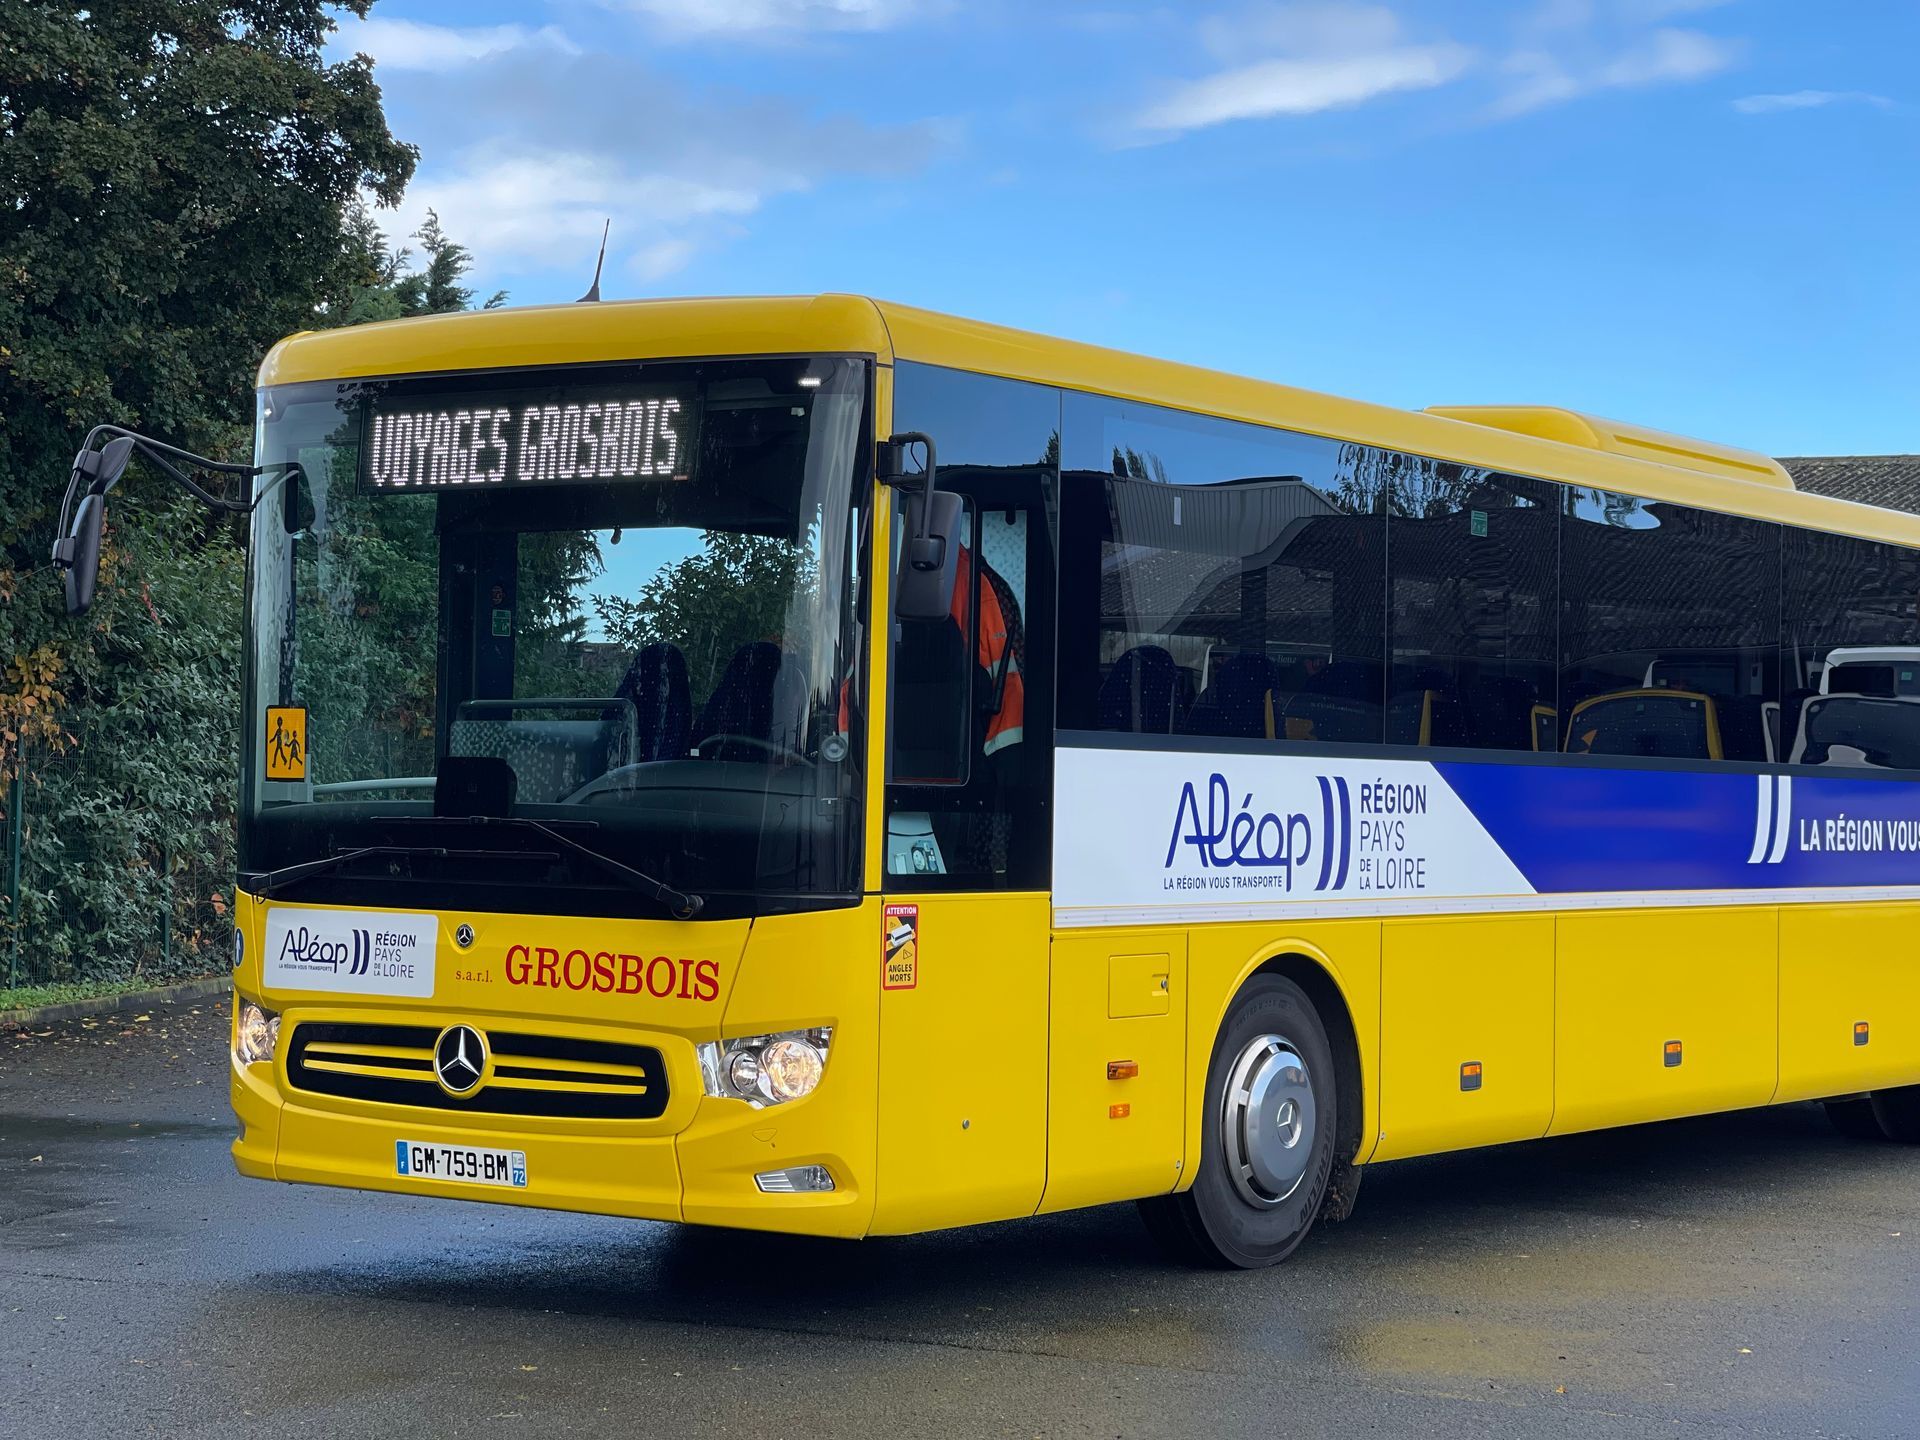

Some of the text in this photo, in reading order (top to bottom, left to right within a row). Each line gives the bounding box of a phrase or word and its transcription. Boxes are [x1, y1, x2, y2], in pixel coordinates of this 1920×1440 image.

[371, 398, 681, 486] VOYAGES GROSBOIS
[1360, 777, 1427, 815] RÉGION
[1360, 820, 1405, 851] PAYS
[1800, 819, 1821, 851] LA
[1825, 813, 1883, 851] RÉGION
[1359, 857, 1426, 889] DE LOIRE
[1163, 874, 1283, 890] LA RÉGION VOUS TRANSPORTE
[1359, 876, 1371, 890] LA
[886, 907, 917, 915] ATTENTION
[375, 930, 417, 948] RÉGION
[374, 947, 402, 963] PAYS
[373, 962, 415, 979] DE LOIRE
[455, 969, 493, 983] s.a.r.l.
[505, 944, 720, 1002] GROSBOIS
[888, 964, 912, 973] ANGLES
[889, 974, 911, 982] MORTS
[412, 1146, 509, 1181] GM-759-BM
[512, 1169, 525, 1184] 72
